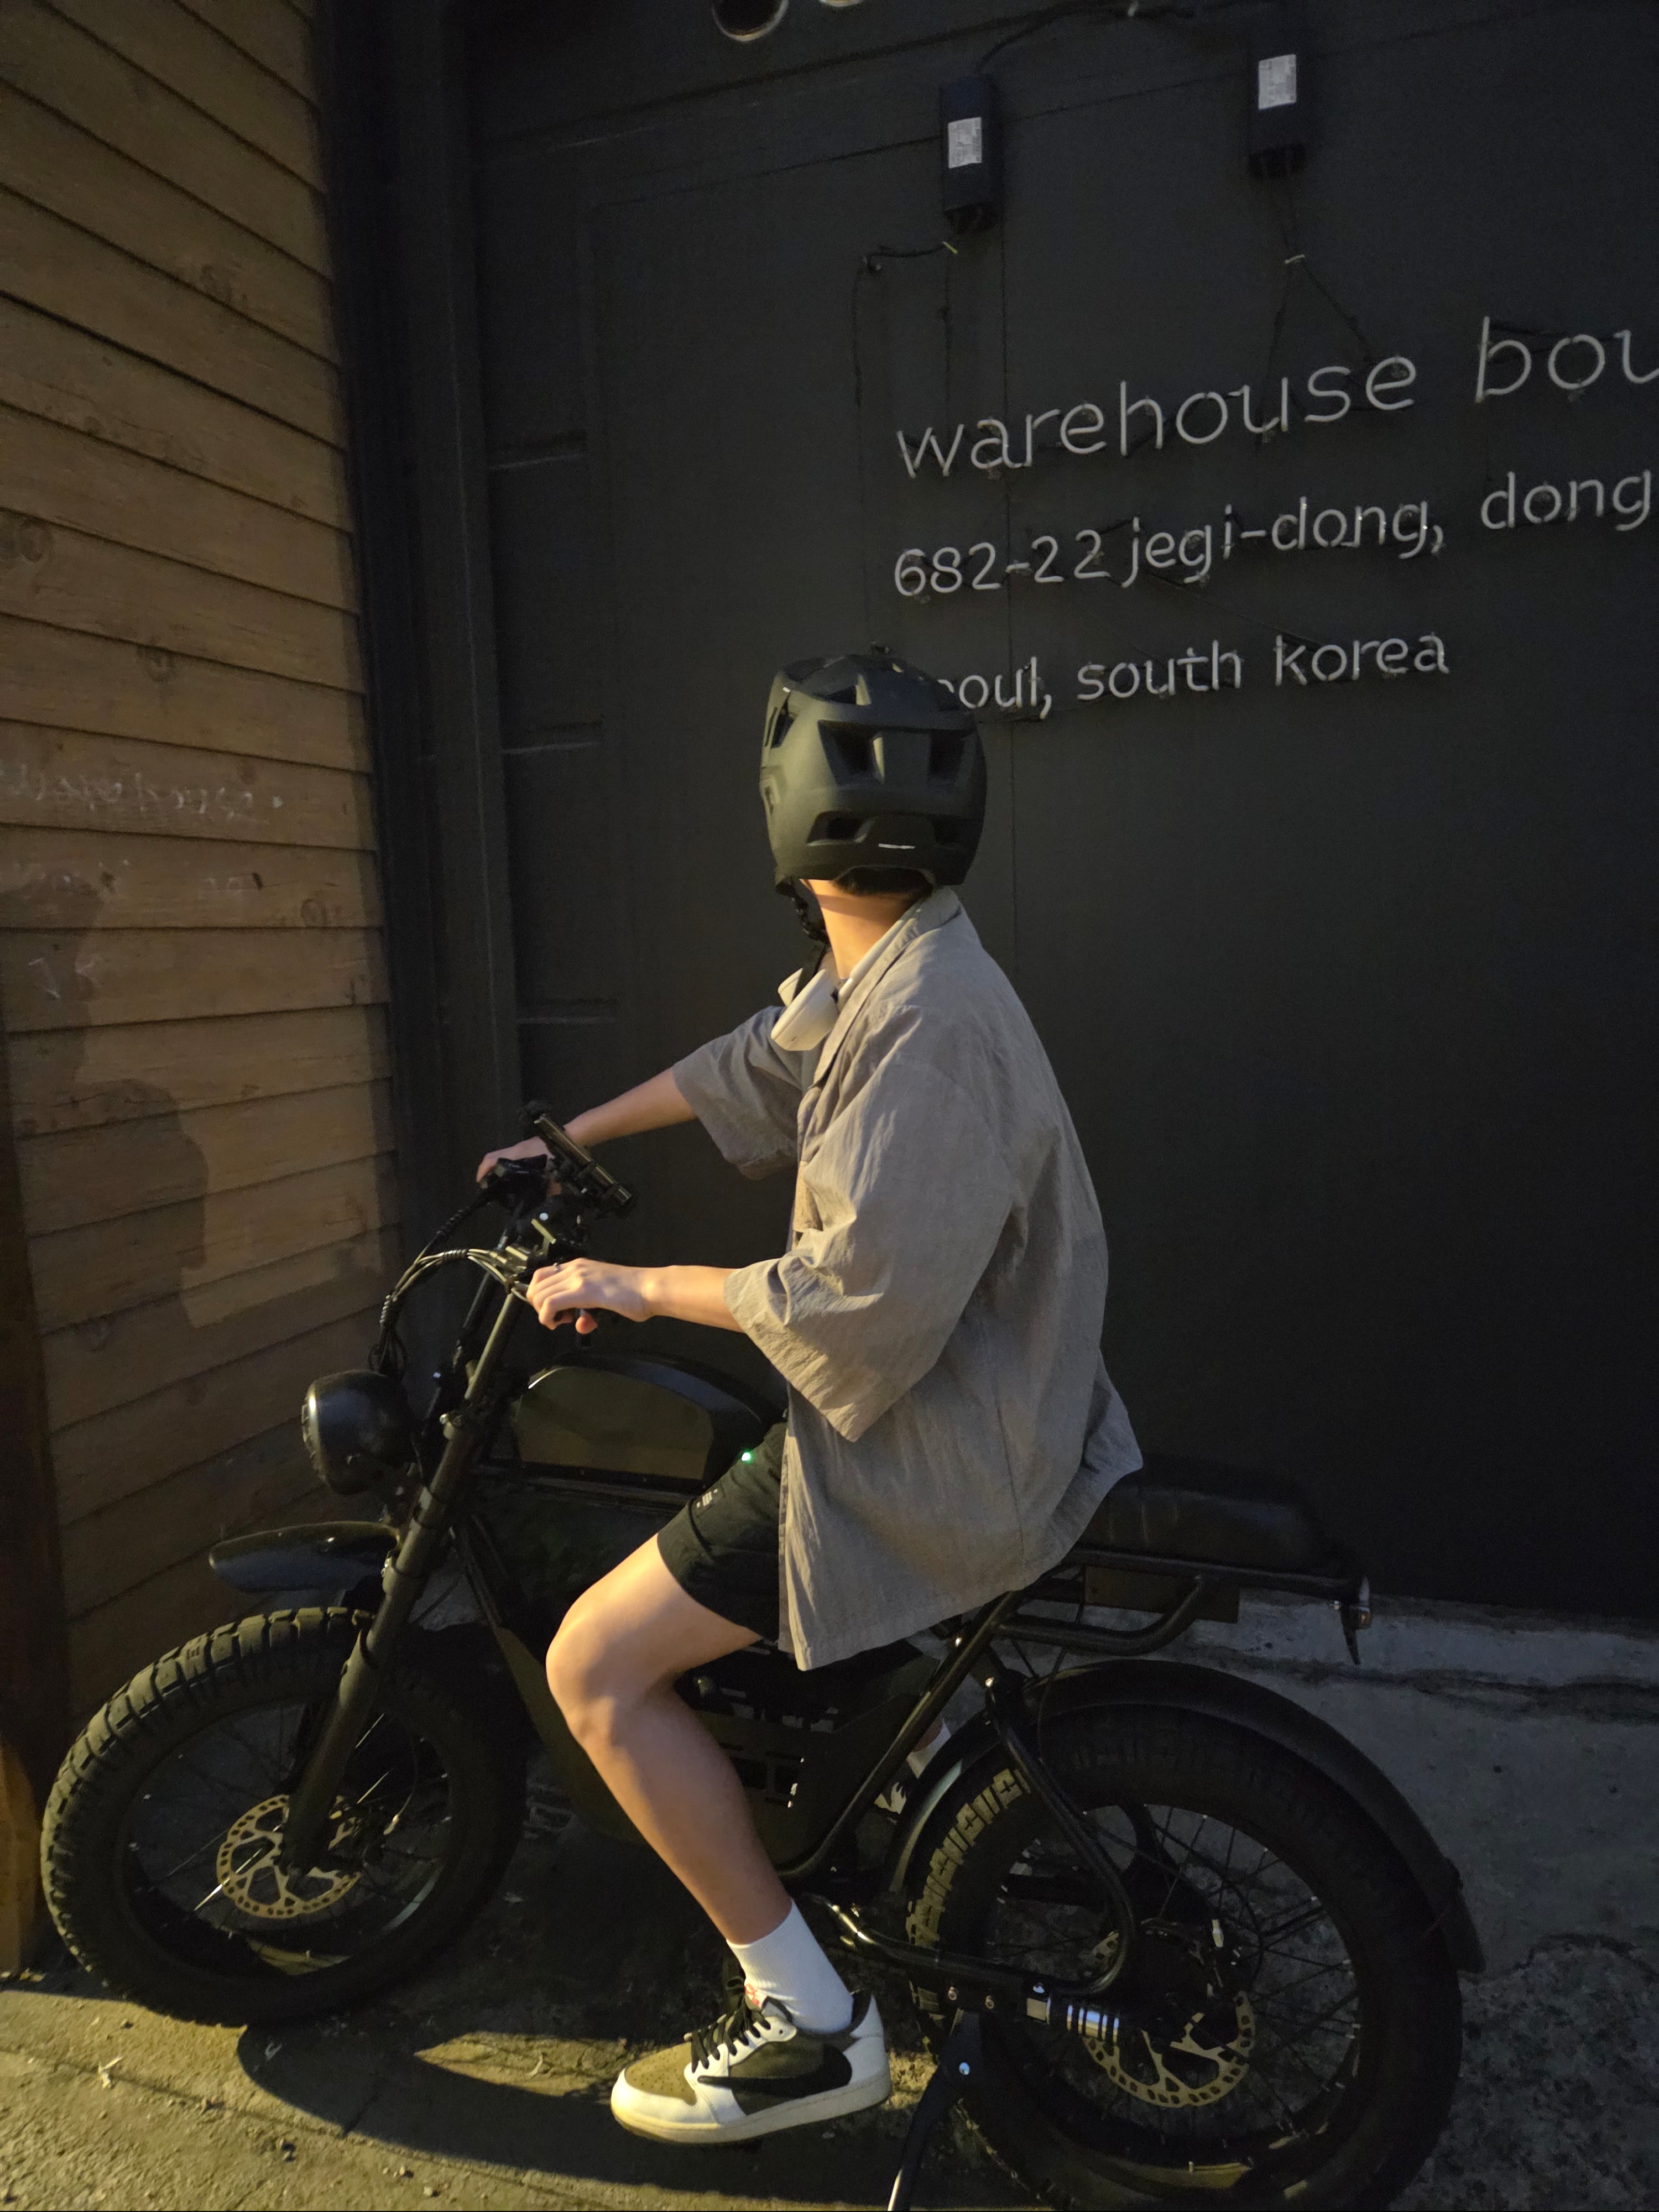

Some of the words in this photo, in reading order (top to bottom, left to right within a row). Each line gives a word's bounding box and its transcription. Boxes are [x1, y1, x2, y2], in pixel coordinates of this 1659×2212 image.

[896, 356, 1417, 478] warehouse
[894, 529, 1110, 597] 682-22
[1121, 495, 1444, 588] jegi-dong,
[1480, 469, 1651, 531] dong
[937, 656, 1052, 719] oul,
[1077, 639, 1242, 701] south
[1275, 634, 1450, 685] korea
